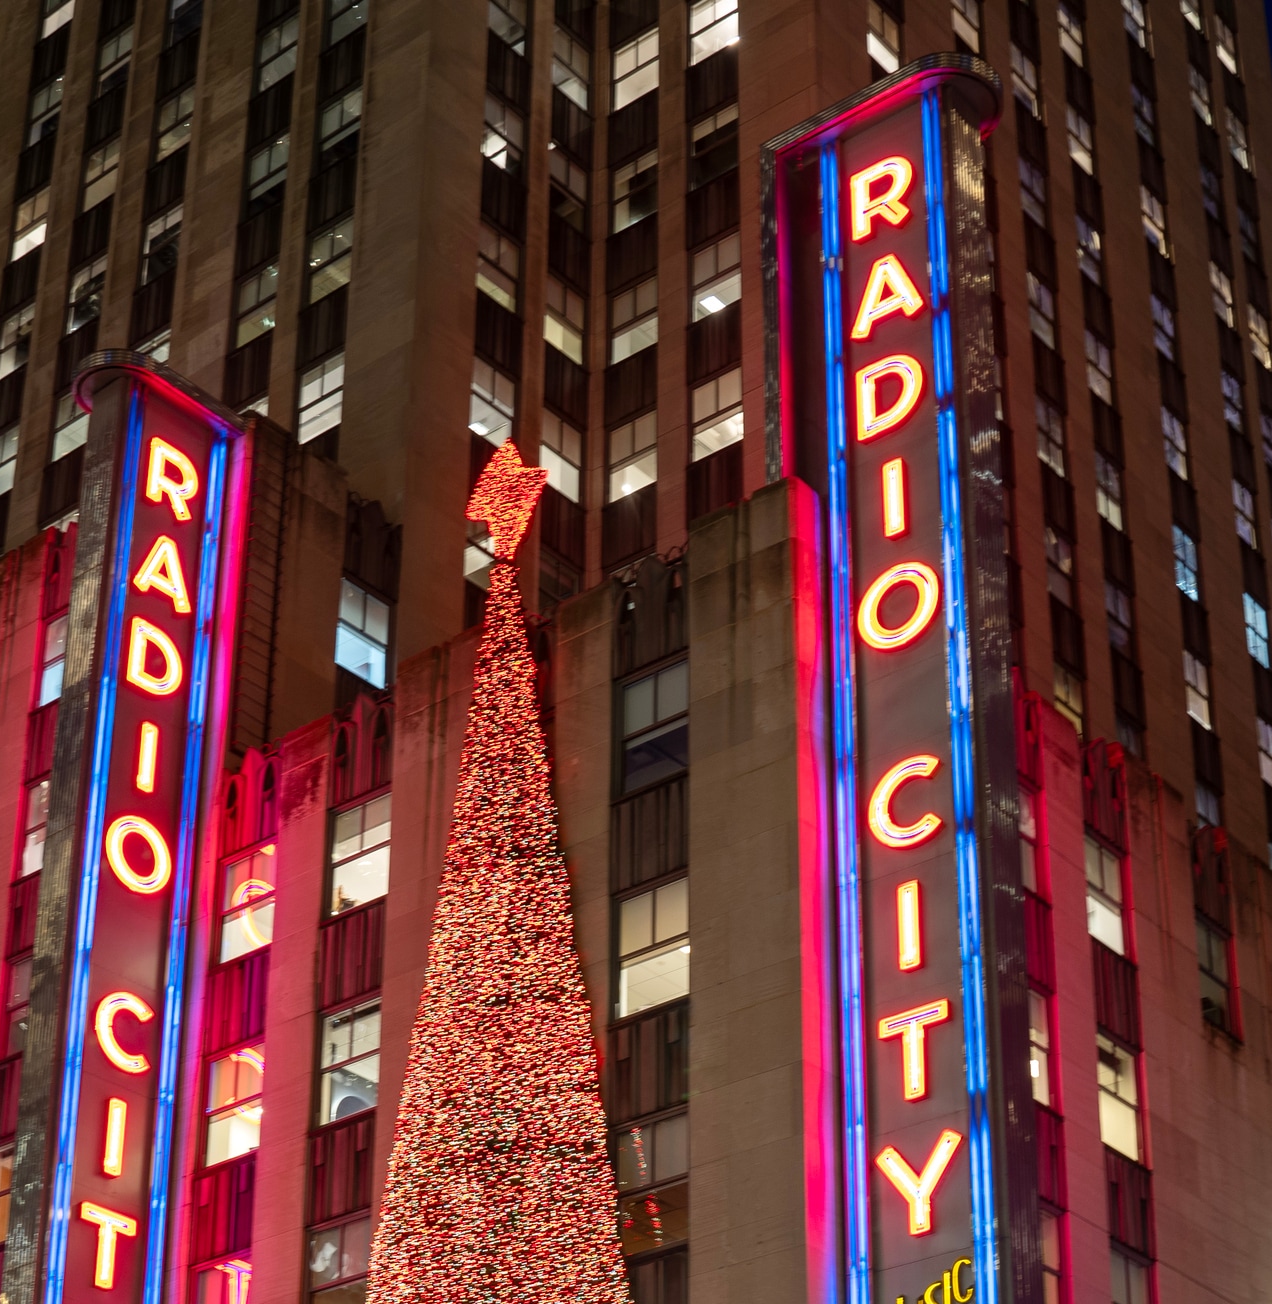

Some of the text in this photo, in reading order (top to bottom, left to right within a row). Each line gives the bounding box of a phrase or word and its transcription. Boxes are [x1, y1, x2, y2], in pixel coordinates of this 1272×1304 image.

[104, 436, 199, 896] RADIO
[849, 155, 965, 1237] RADIO CITY
